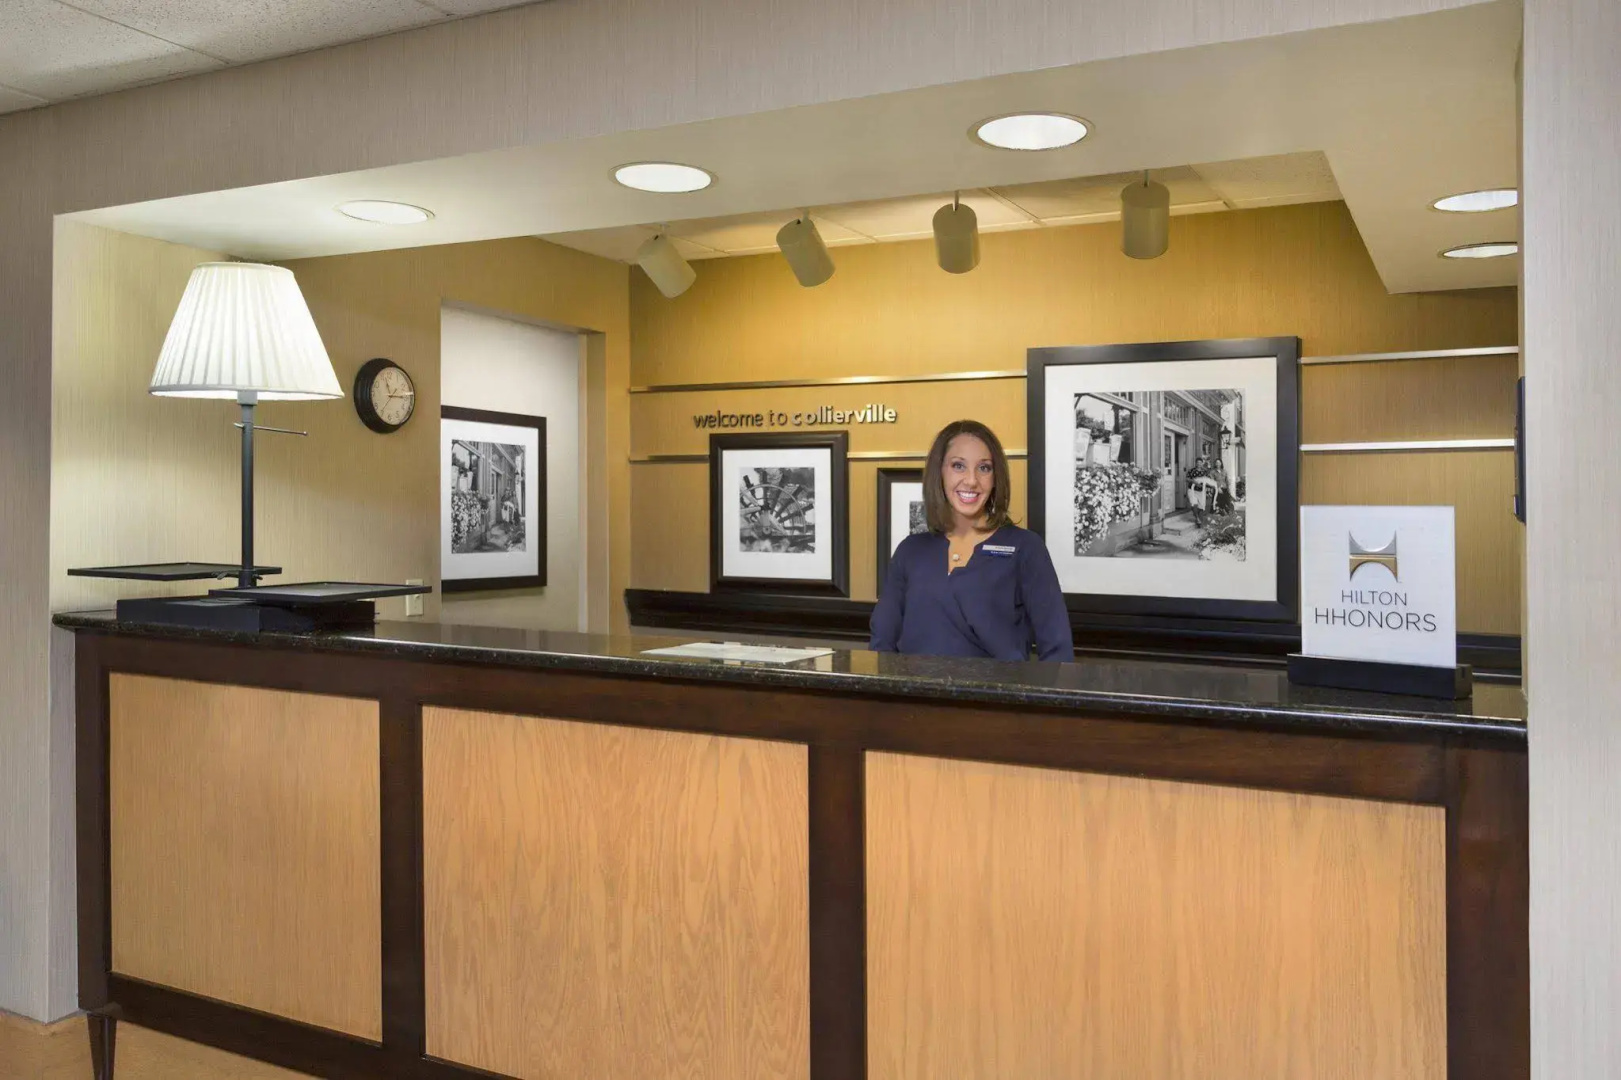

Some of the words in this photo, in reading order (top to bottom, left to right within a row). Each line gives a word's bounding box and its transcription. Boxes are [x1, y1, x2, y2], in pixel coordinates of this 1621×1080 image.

[693, 410, 763, 428] welcome
[769, 409, 788, 427] to
[791, 404, 898, 425] collierville
[1341, 589, 1408, 606] HILTON
[1314, 607, 1437, 632] HHONORS
